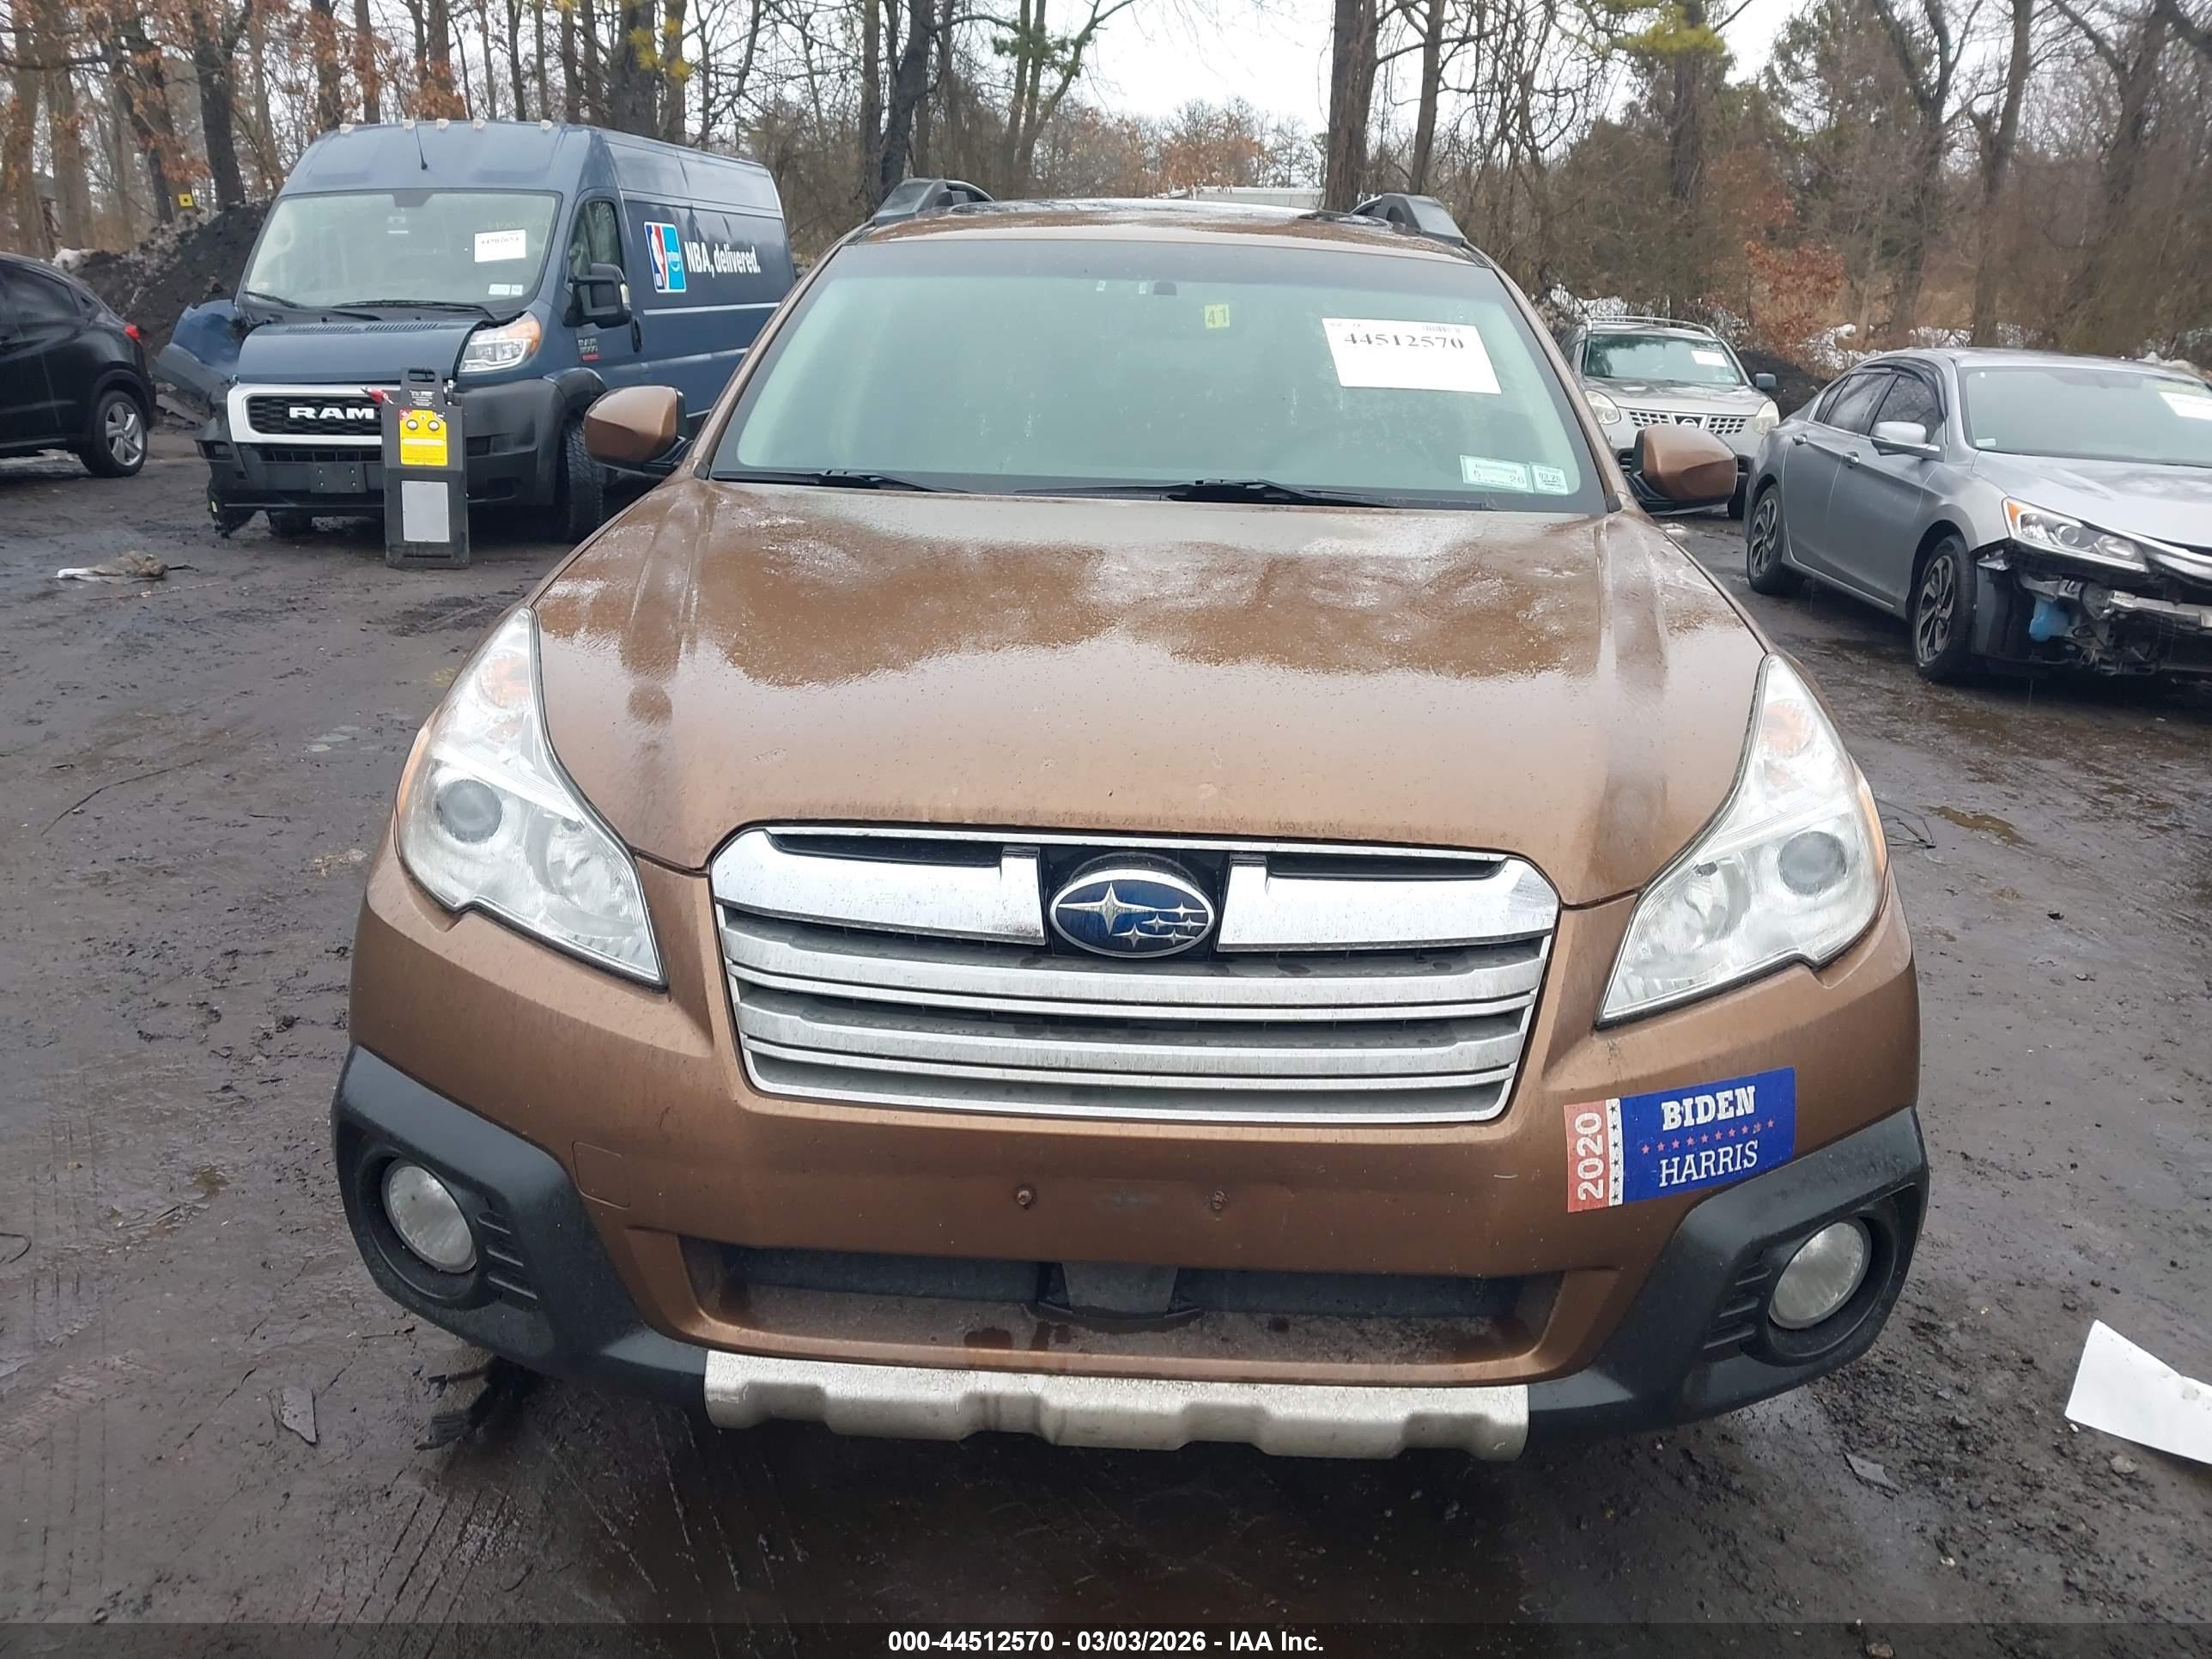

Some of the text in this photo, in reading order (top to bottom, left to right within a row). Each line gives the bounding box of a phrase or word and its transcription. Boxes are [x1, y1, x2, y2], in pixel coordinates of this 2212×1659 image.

[684, 241, 761, 278] NBA, delivered.
[1344, 333, 1464, 349] 44512570
[289, 407, 374, 419] RAM
[1662, 1085, 1756, 1131] BIDEN
[1575, 1112, 1605, 1201] 2020
[1659, 1139, 1758, 1188] HARRIS
